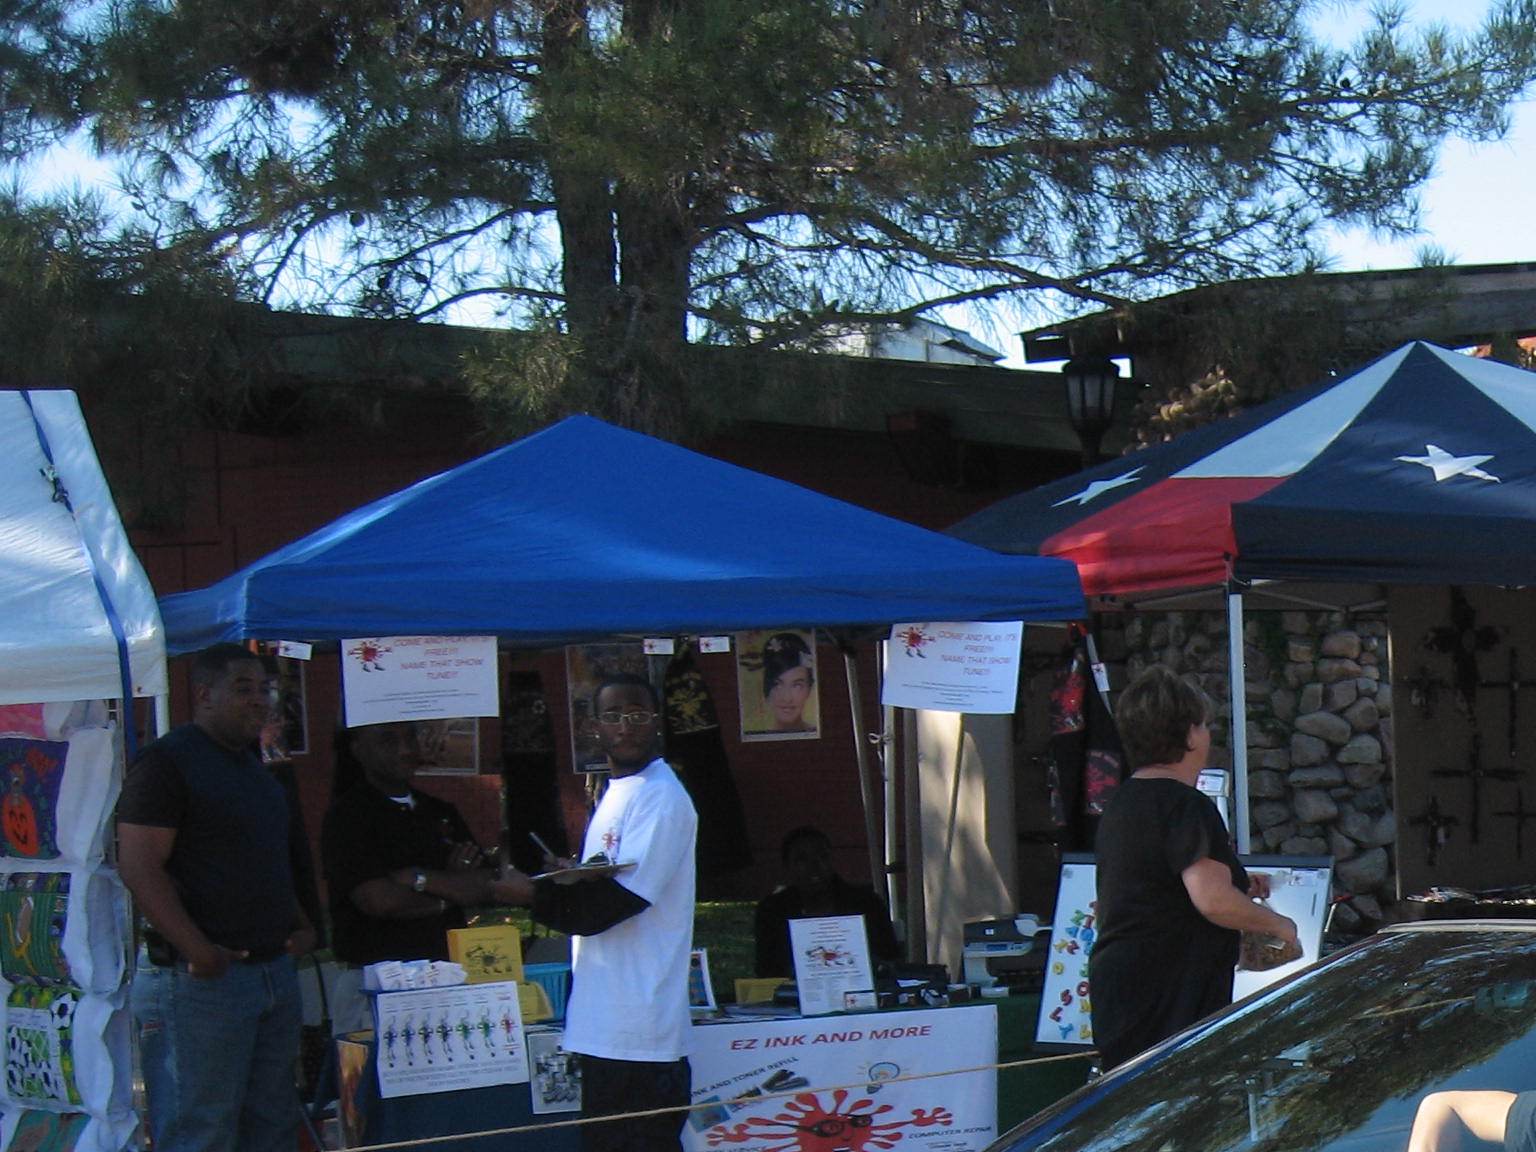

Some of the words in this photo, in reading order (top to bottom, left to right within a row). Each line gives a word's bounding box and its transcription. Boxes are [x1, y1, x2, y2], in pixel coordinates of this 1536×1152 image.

[731, 1039, 757, 1051] EZ
[764, 1034, 805, 1049] INK
[811, 1031, 863, 1044] AND
[869, 1025, 932, 1039] MORE
[710, 1079, 732, 1091] AND
[733, 1067, 766, 1083] TONER
[767, 1056, 799, 1070] REFILL
[908, 1129, 962, 1139] COMPUTER
